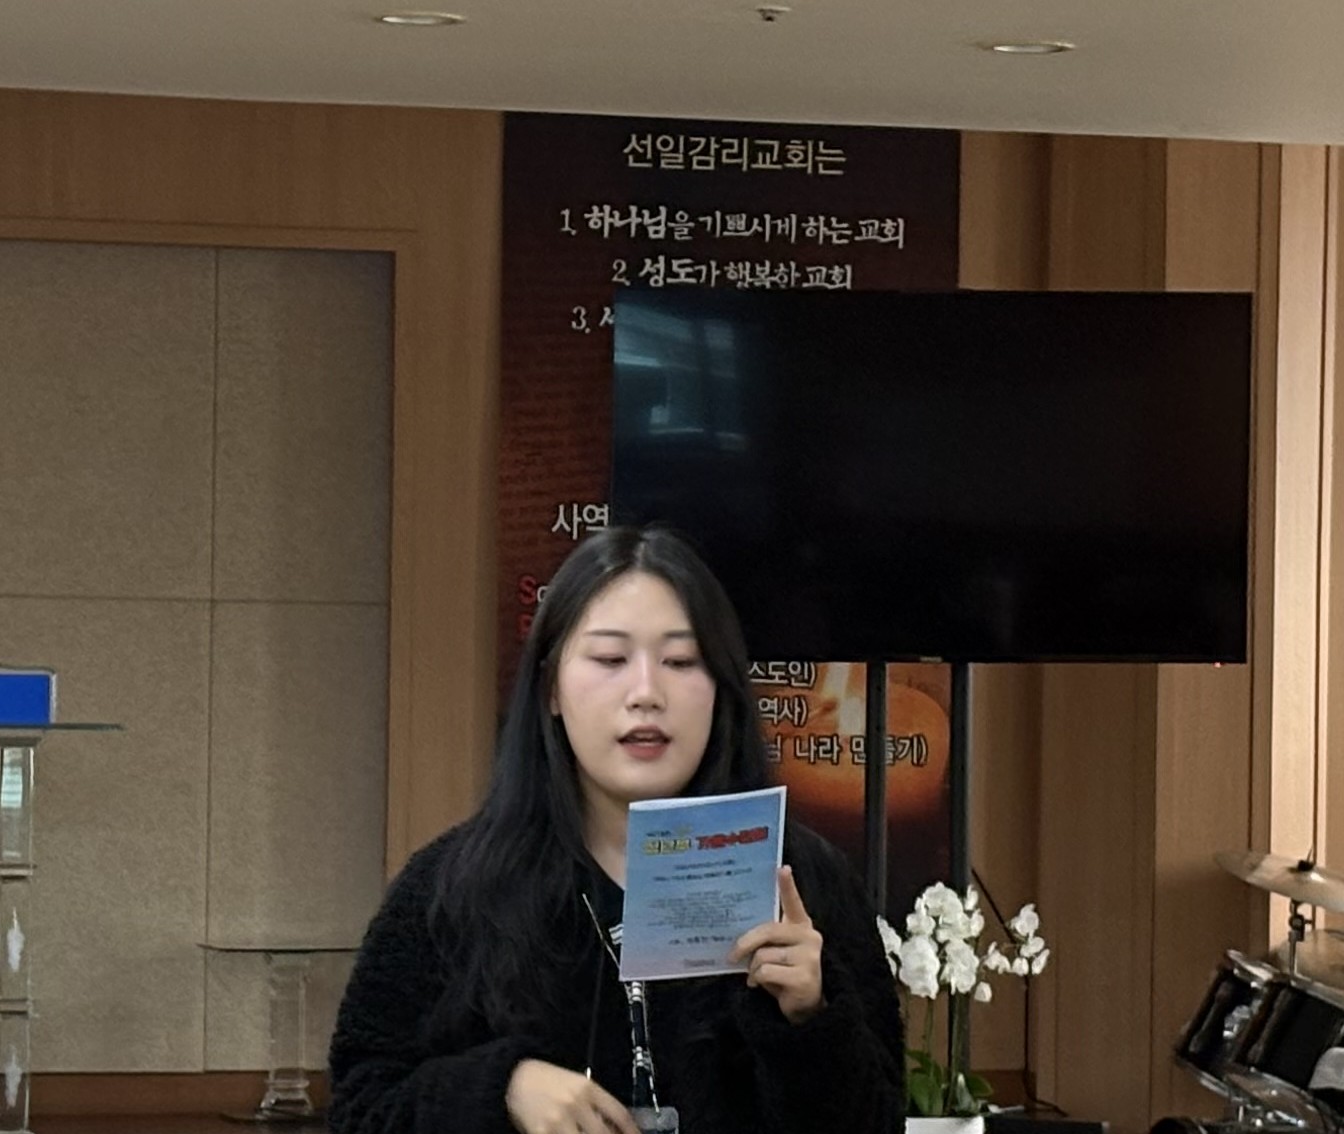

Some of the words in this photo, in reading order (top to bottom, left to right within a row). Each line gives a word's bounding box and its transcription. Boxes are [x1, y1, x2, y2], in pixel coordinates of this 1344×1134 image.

[623, 133, 847, 175] 선일감리교회는
[560, 208, 577, 235] 1.
[584, 205, 695, 240] 하나님을
[698, 210, 796, 243] 기쁘시게
[802, 215, 853, 245] 하는
[854, 217, 905, 249] 교회
[612, 259, 631, 286] 2.
[639, 255, 720, 288] 성도가
[802, 264, 852, 289] 교회
[571, 306, 591, 334] 3.
[551, 503, 609, 540] 사역
[758, 696, 807, 726] 역사)
[795, 735, 840, 764] 나라
